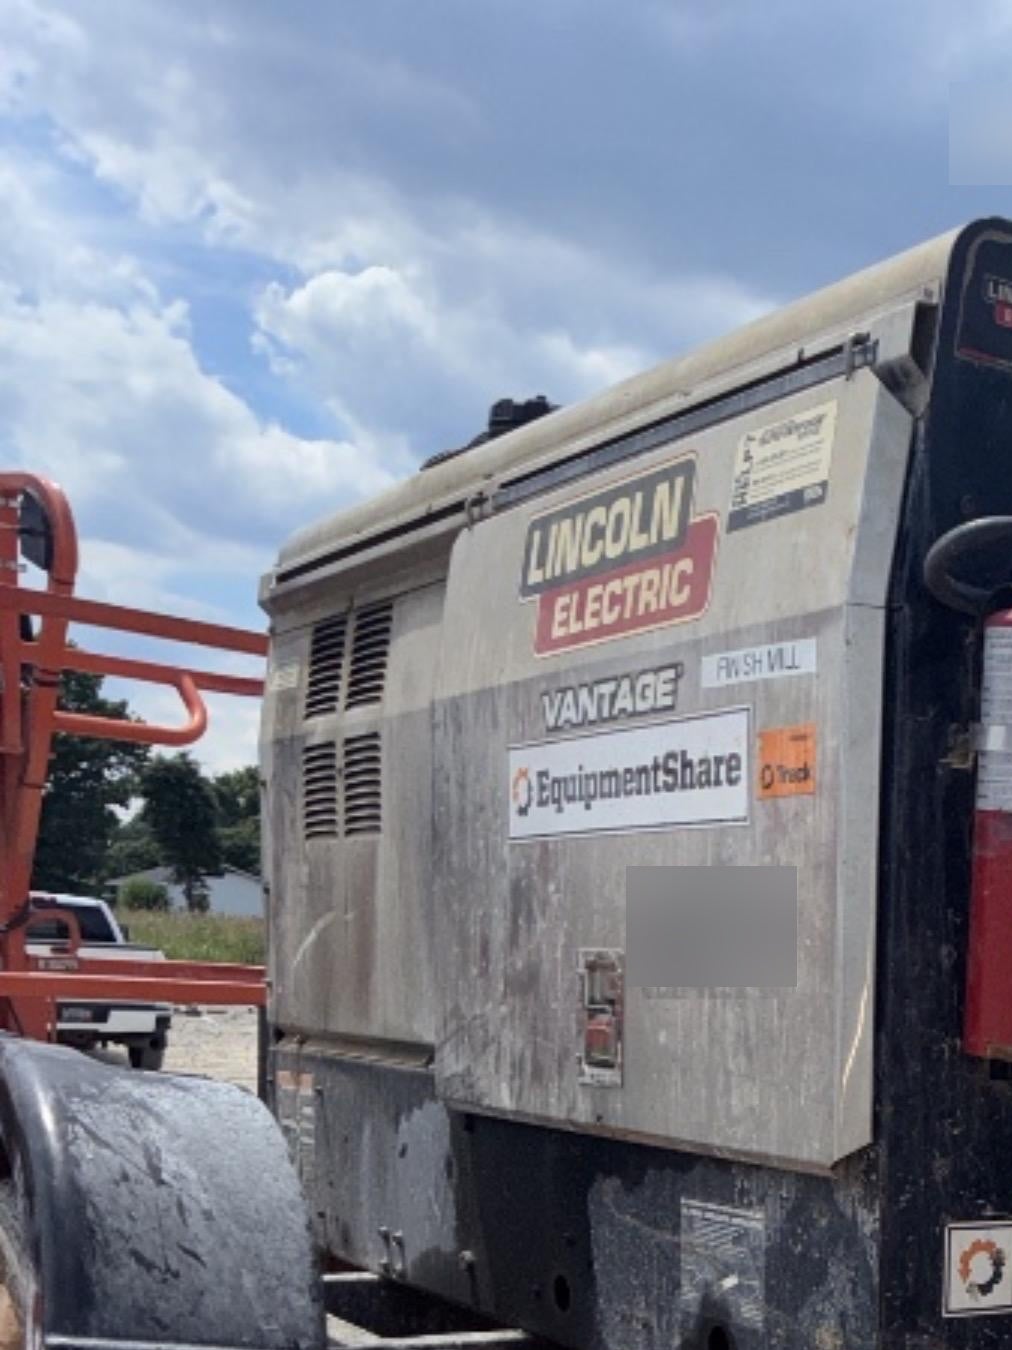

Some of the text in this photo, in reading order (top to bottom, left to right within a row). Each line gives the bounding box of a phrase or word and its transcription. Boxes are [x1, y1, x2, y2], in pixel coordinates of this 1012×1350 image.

[526, 475, 686, 586] LINCOLN
[551, 557, 694, 640] ELECTRIC
[540, 665, 679, 731] VANTAGE
[535, 749, 743, 814] EquipmentShare
